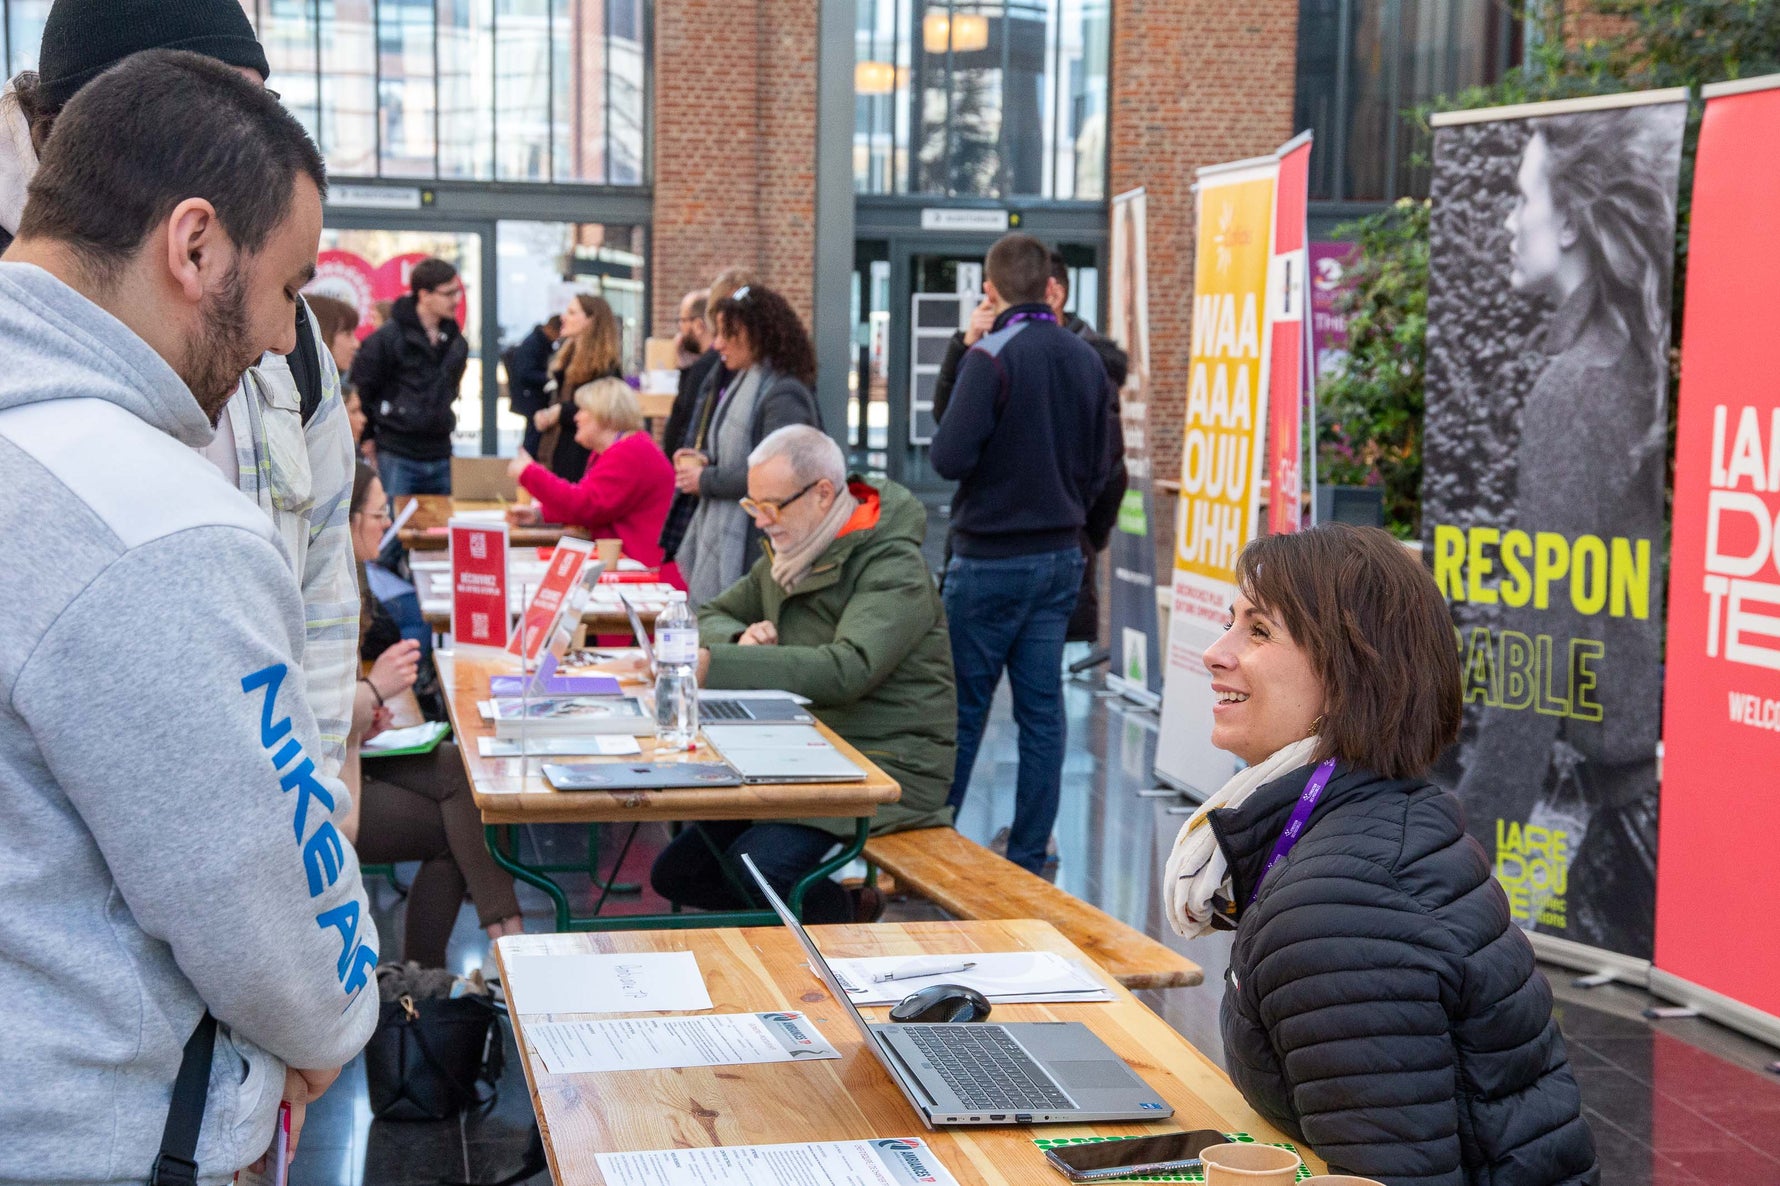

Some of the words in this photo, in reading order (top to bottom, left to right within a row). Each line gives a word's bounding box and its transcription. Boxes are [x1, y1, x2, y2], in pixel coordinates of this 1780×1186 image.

[1193, 292, 1259, 358] WAA
[1187, 362, 1250, 431] AAA
[1182, 428, 1249, 500] OUU
[1178, 499, 1241, 571] UHH
[1704, 489, 1780, 577] D
[1434, 523, 1651, 621] RESPON
[1453, 625, 1605, 722] ABLE
[241, 663, 335, 898] NIKE
[1496, 851, 1568, 895] DOU
[1500, 883, 1530, 920] E
